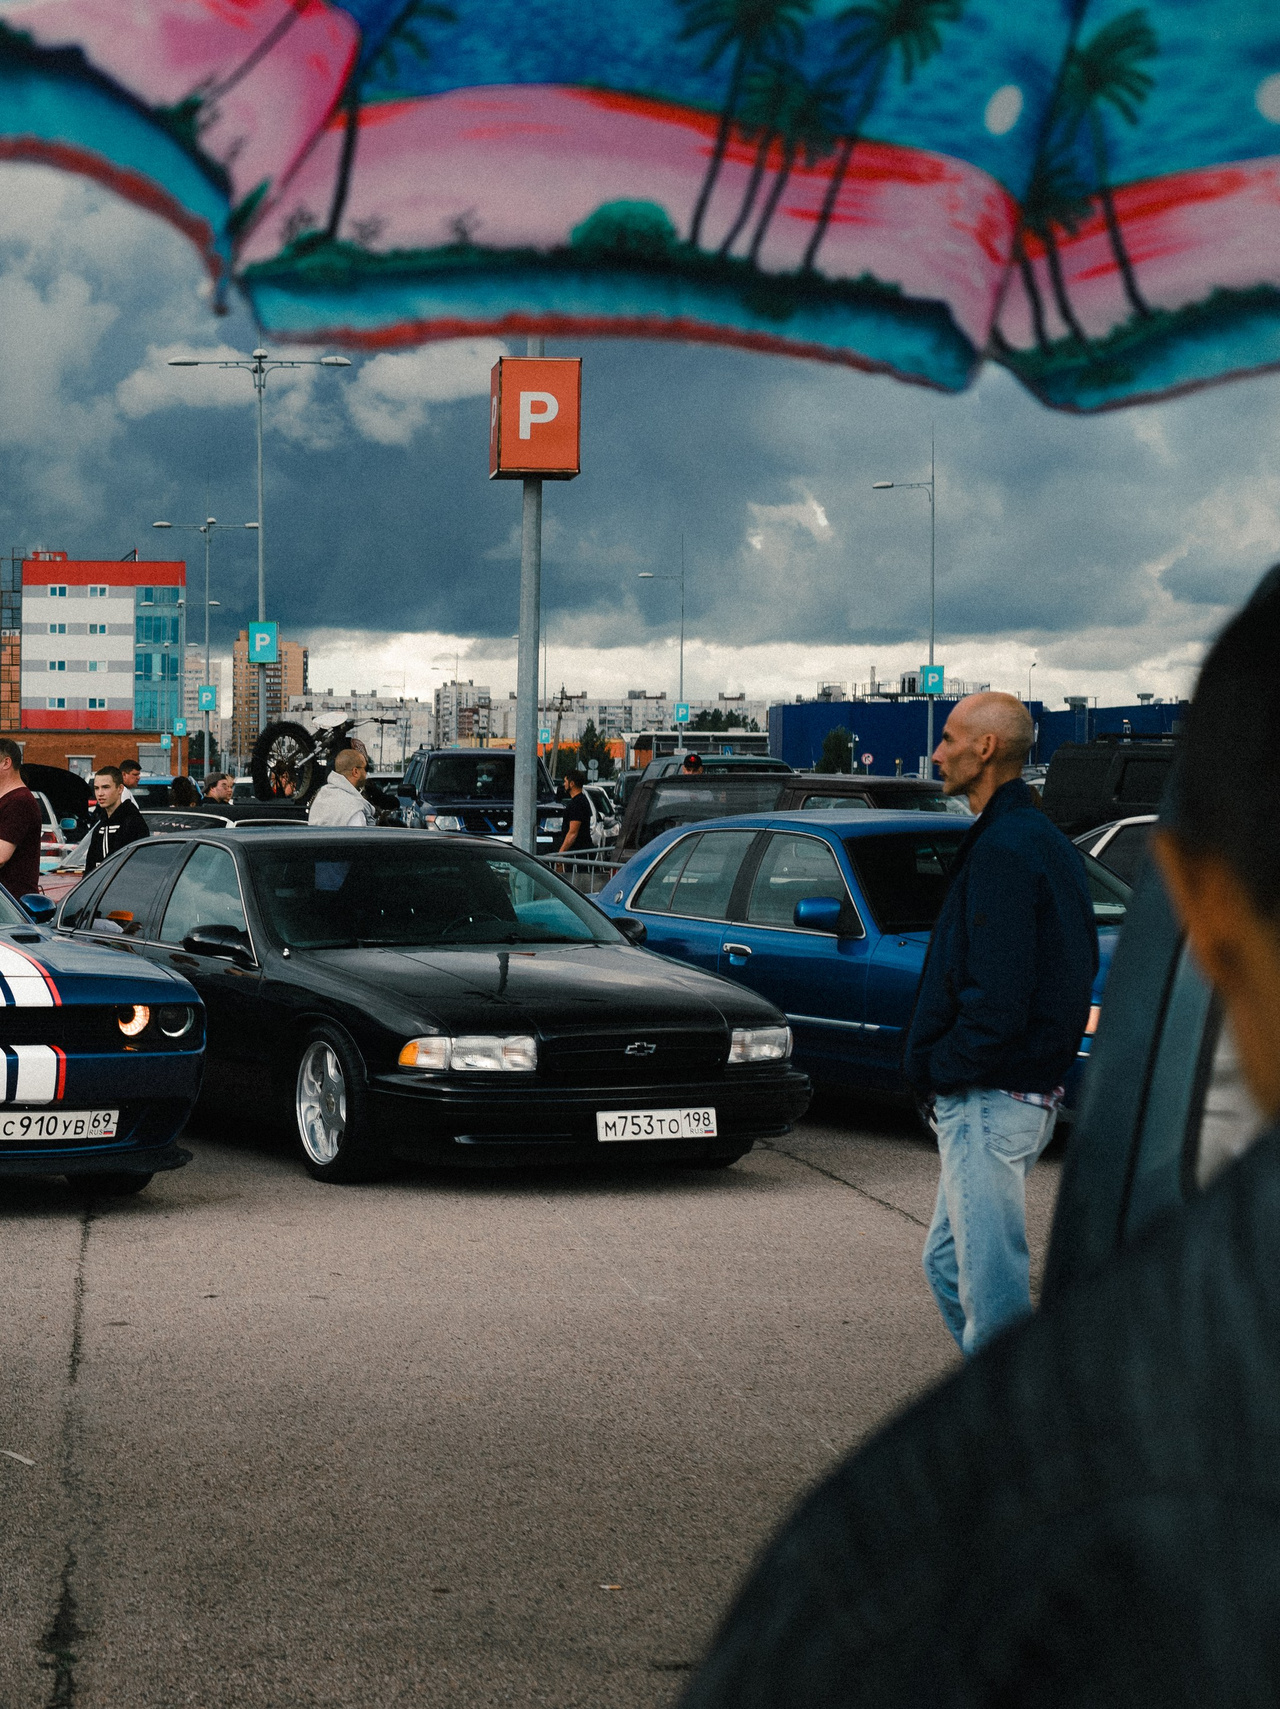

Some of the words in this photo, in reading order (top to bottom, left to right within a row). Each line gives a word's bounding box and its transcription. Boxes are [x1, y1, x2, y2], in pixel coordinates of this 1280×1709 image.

[519, 391, 559, 440] P
[255, 633, 271, 651] P
[928, 673, 939, 687] P
[202, 692, 212, 704] P
[678, 707, 687, 718] P
[176, 722, 184, 731] P
[542, 731, 548, 740] P
[2, 1115, 86, 1137] С910УВ
[91, 1112, 112, 1129] 69
[604, 1115, 680, 1137] М753ТО
[683, 1111, 711, 1128] 198
[88, 1128, 103, 1136] RUS
